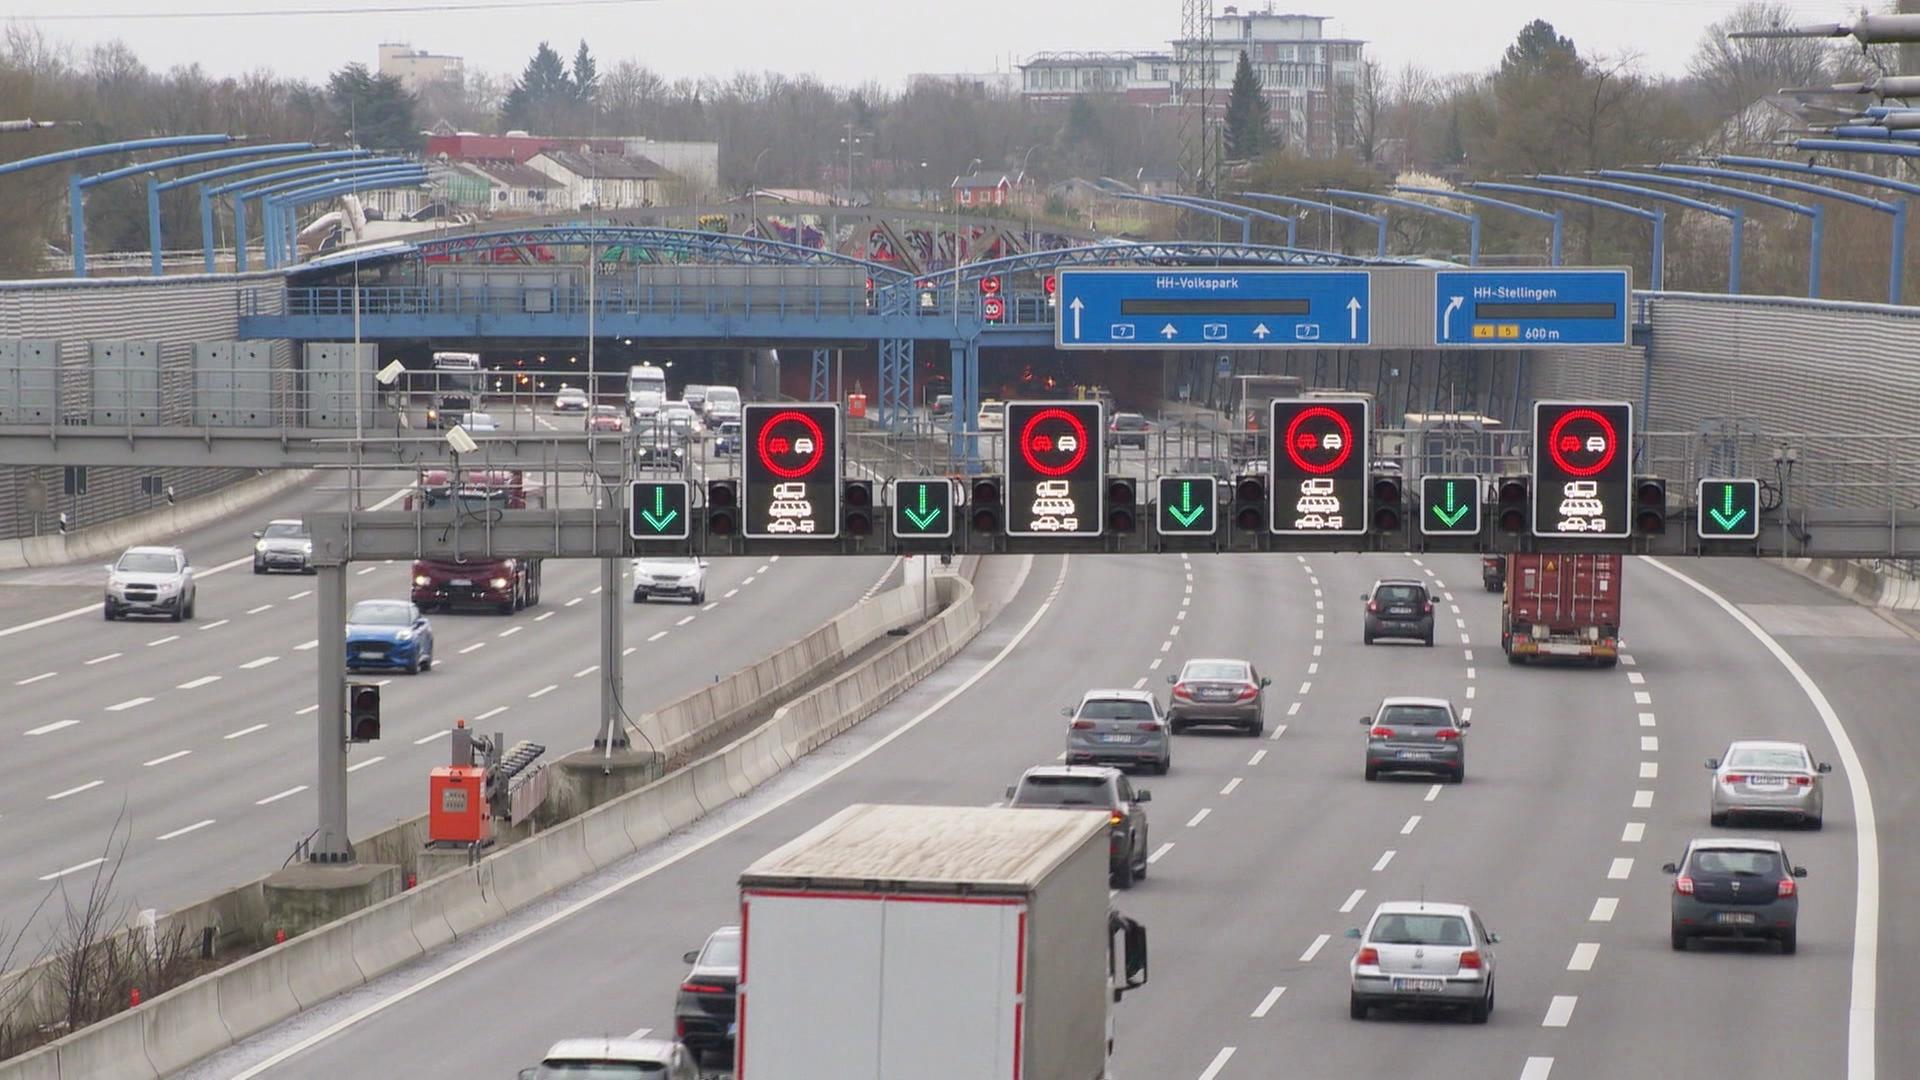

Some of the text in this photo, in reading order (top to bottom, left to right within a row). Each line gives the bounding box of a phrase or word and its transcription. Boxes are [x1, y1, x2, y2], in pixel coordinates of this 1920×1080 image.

[1156, 276, 1239, 290] HH-Volkspark
[1473, 287, 1557, 301] HH-Stellingen
[1525, 328, 1560, 339] 600 m
